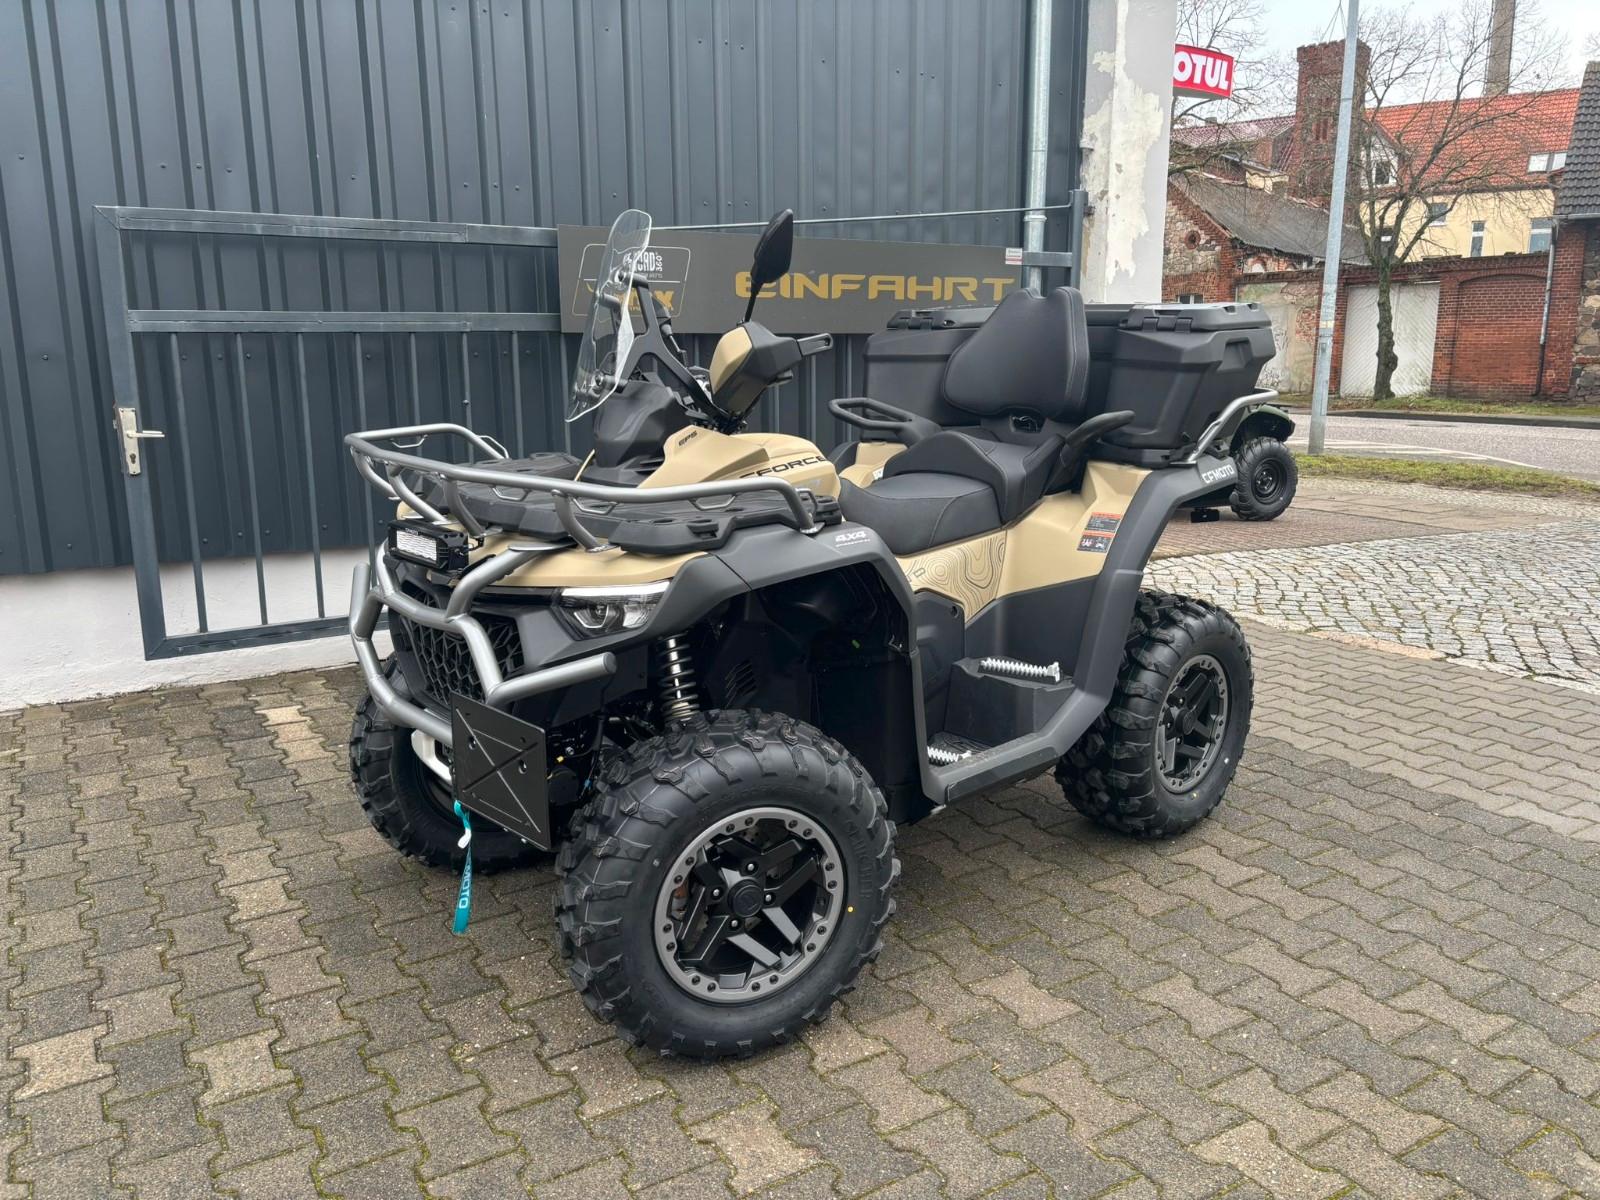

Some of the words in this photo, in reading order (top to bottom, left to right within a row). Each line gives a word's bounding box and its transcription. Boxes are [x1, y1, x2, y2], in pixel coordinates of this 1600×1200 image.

[1173, 51, 1229, 90] OTUL
[735, 271, 1015, 301] EINFAHRT
[1201, 464, 1236, 484] CFMOTO
